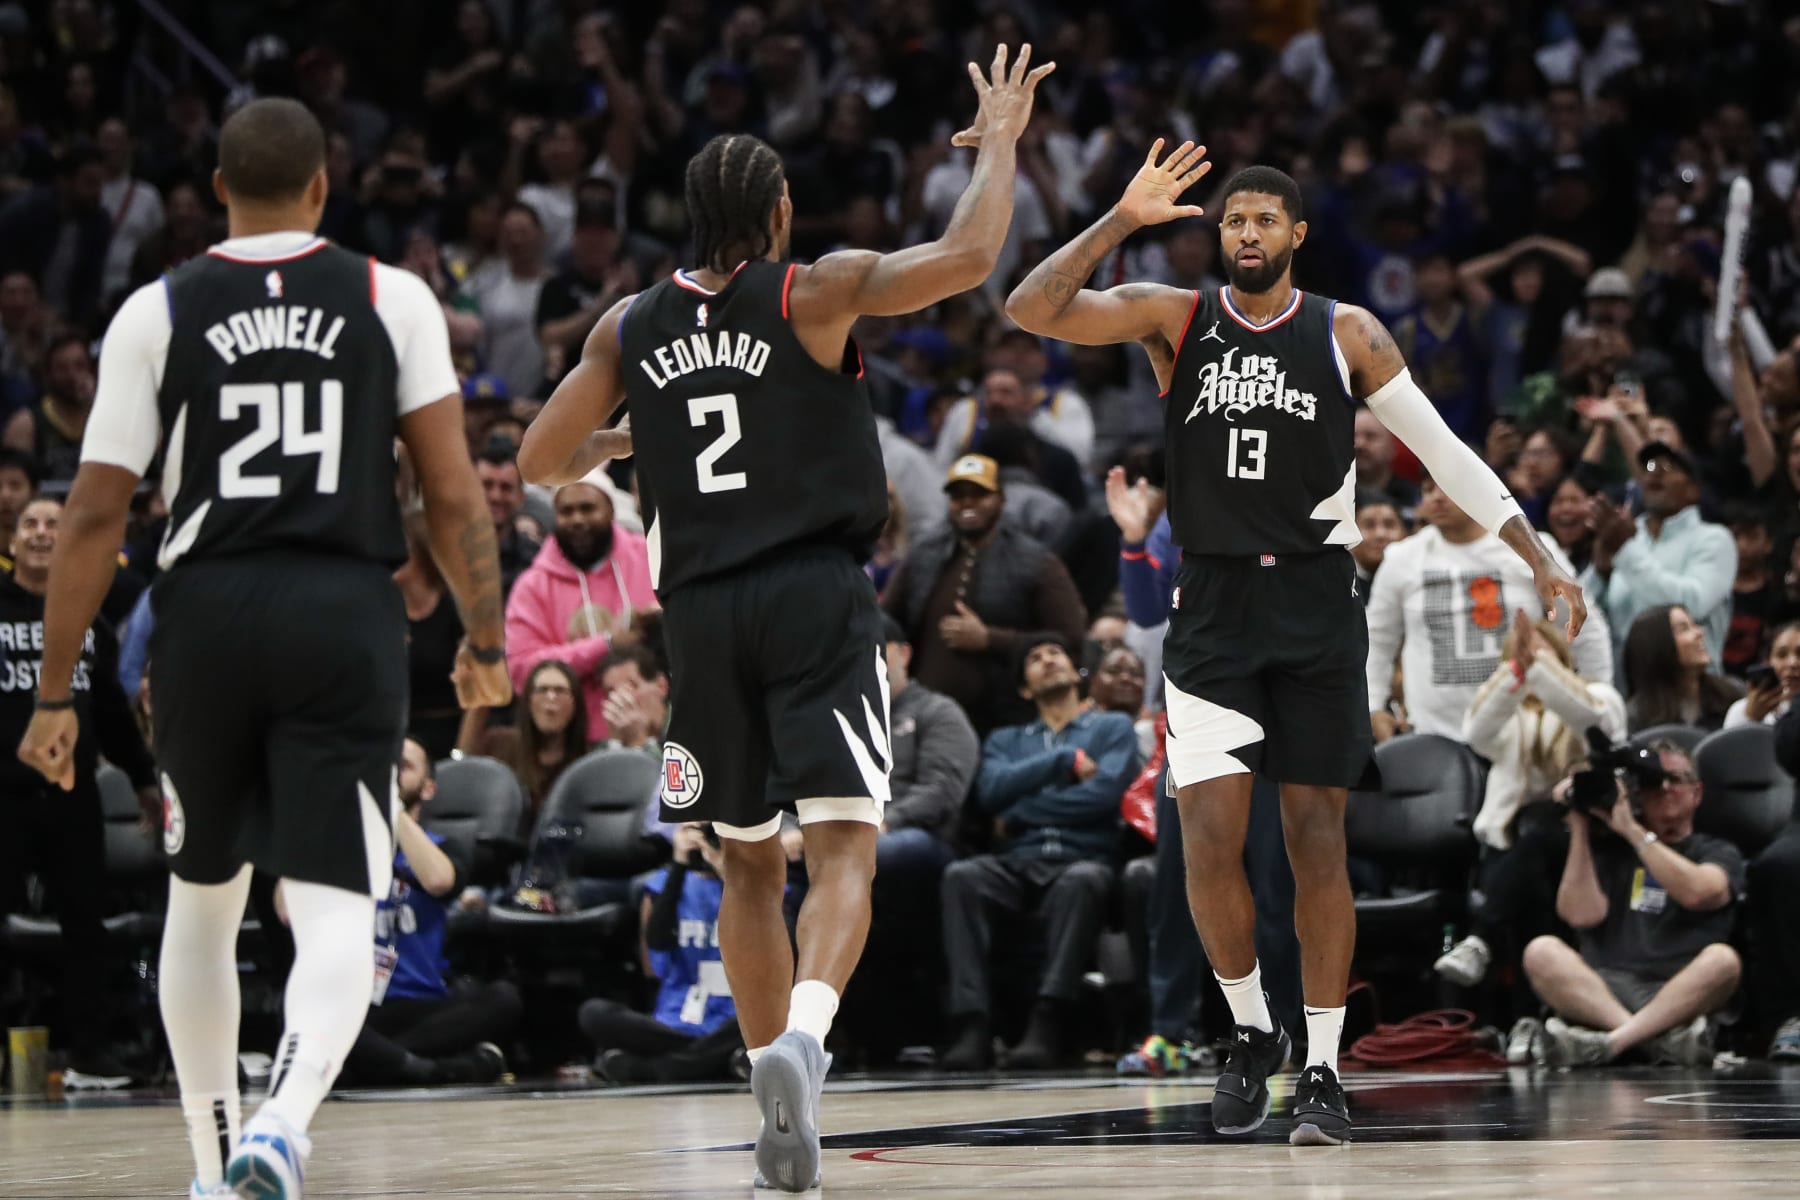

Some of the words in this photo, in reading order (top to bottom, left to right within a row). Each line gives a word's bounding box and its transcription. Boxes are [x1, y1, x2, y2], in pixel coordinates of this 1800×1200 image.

[204, 305, 346, 365] POWELL
[639, 330, 772, 389] LEONARD
[1217, 346, 1279, 383] Los
[1184, 362, 1318, 424] Angeles
[218, 379, 344, 499] 24
[687, 393, 748, 494] 2
[1227, 427, 1268, 480] 13
